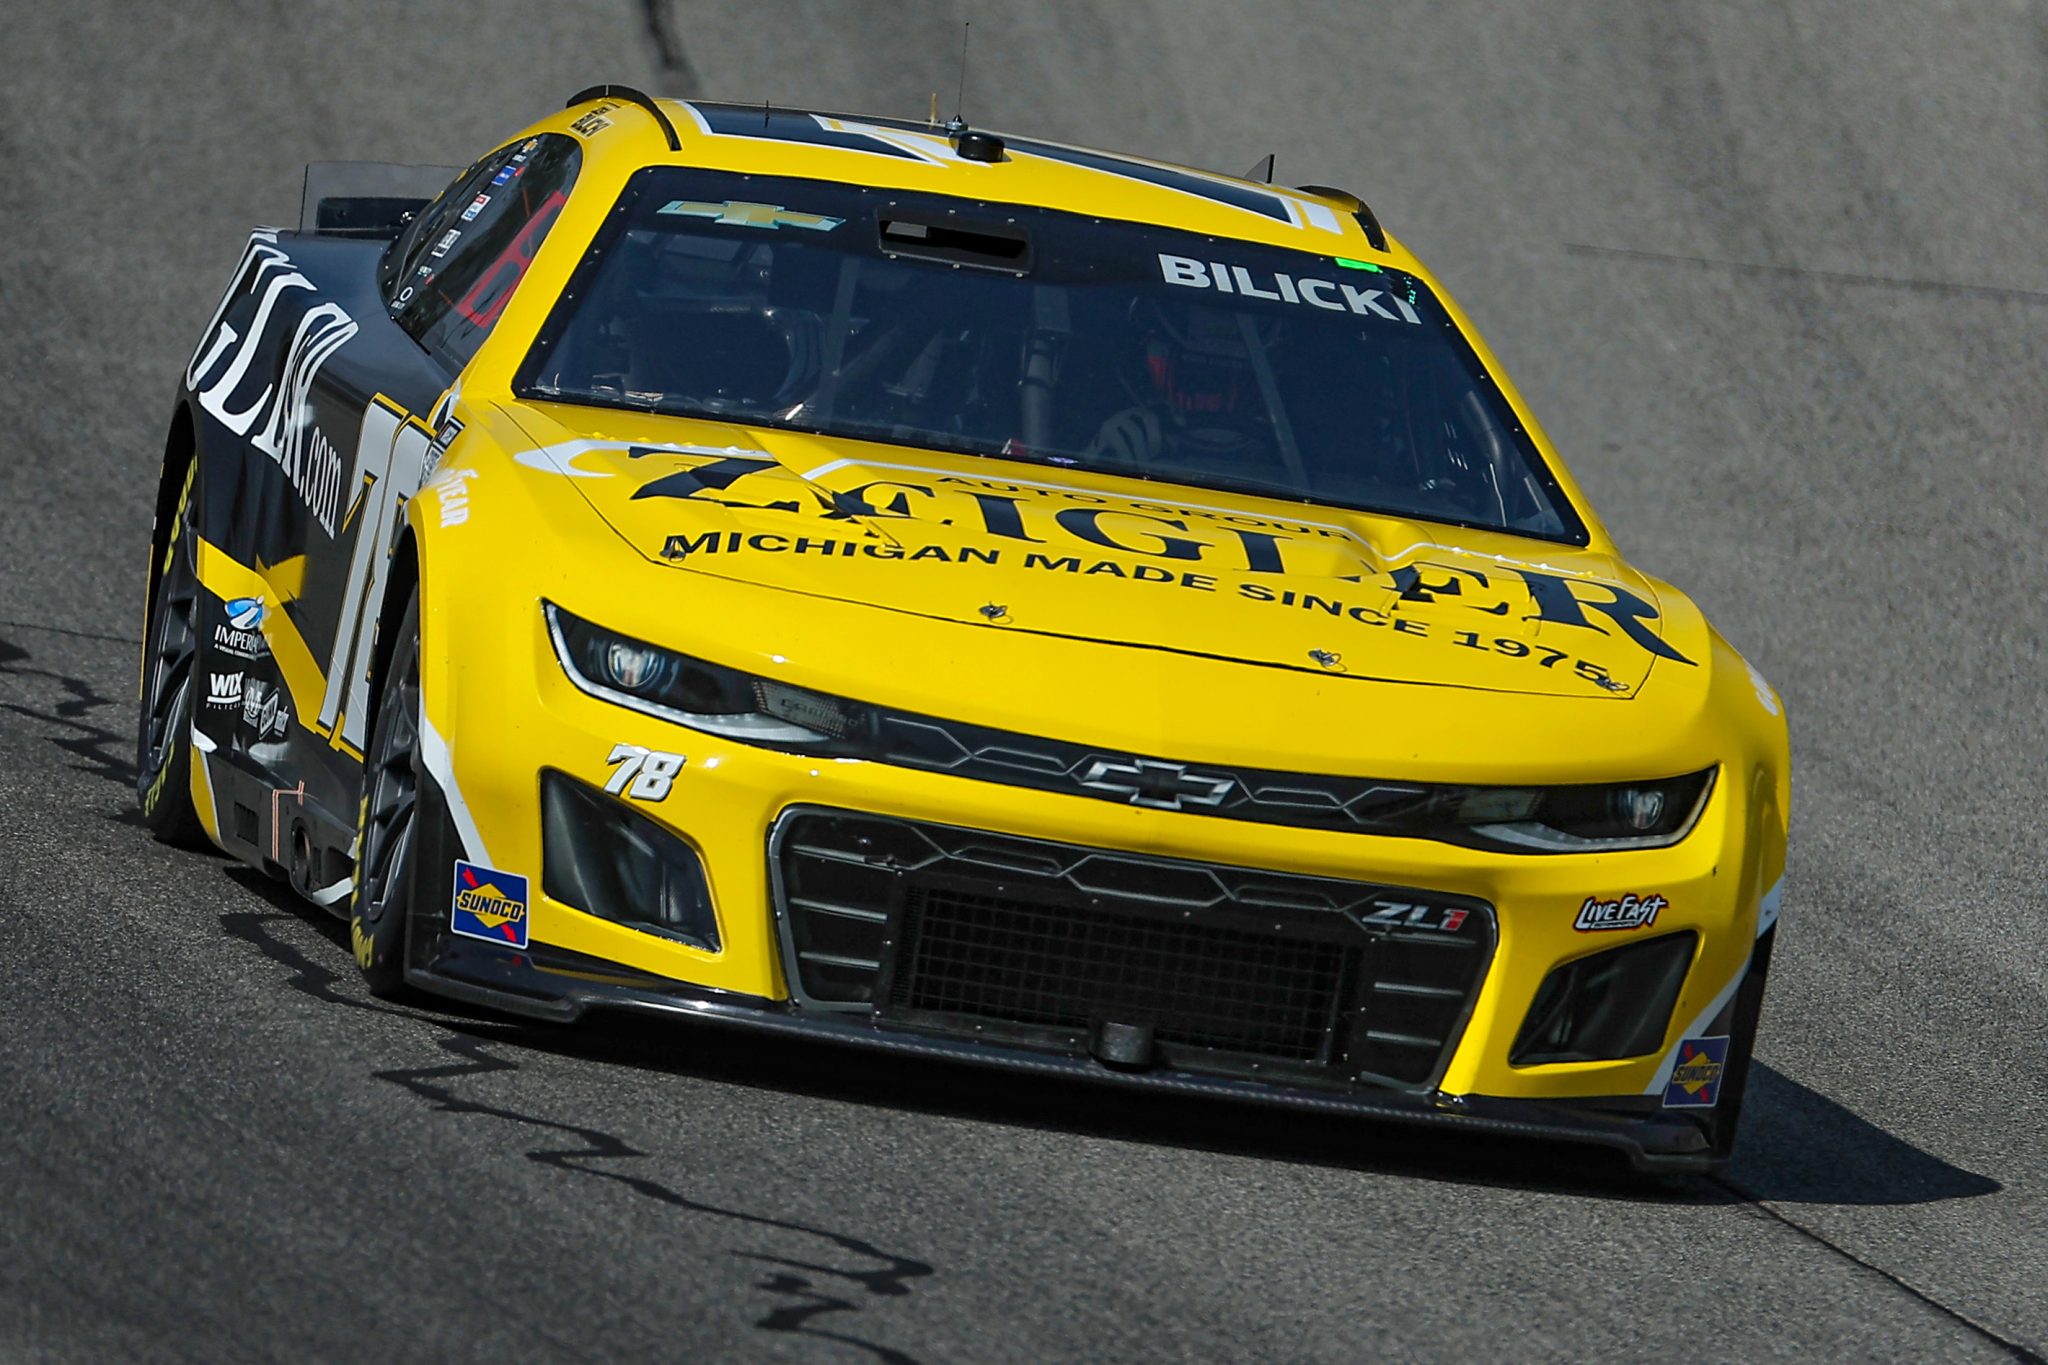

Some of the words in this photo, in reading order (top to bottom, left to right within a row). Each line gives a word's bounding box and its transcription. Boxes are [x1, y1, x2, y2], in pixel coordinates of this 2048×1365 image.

[1157, 253, 1422, 325] BILICKI
[936, 476, 1106, 504] AUTO
[1130, 502, 1352, 542] GROUP
[661, 531, 1000, 565] MICHIGAN
[1023, 553, 1219, 593] MADE
[1238, 582, 1430, 638] SINCE
[1453, 630, 1613, 684] 1975
[209, 671, 244, 697] WIX
[603, 745, 685, 802] 78
[457, 890, 526, 922] SUNOCO
[1361, 901, 1470, 931] ZL1
